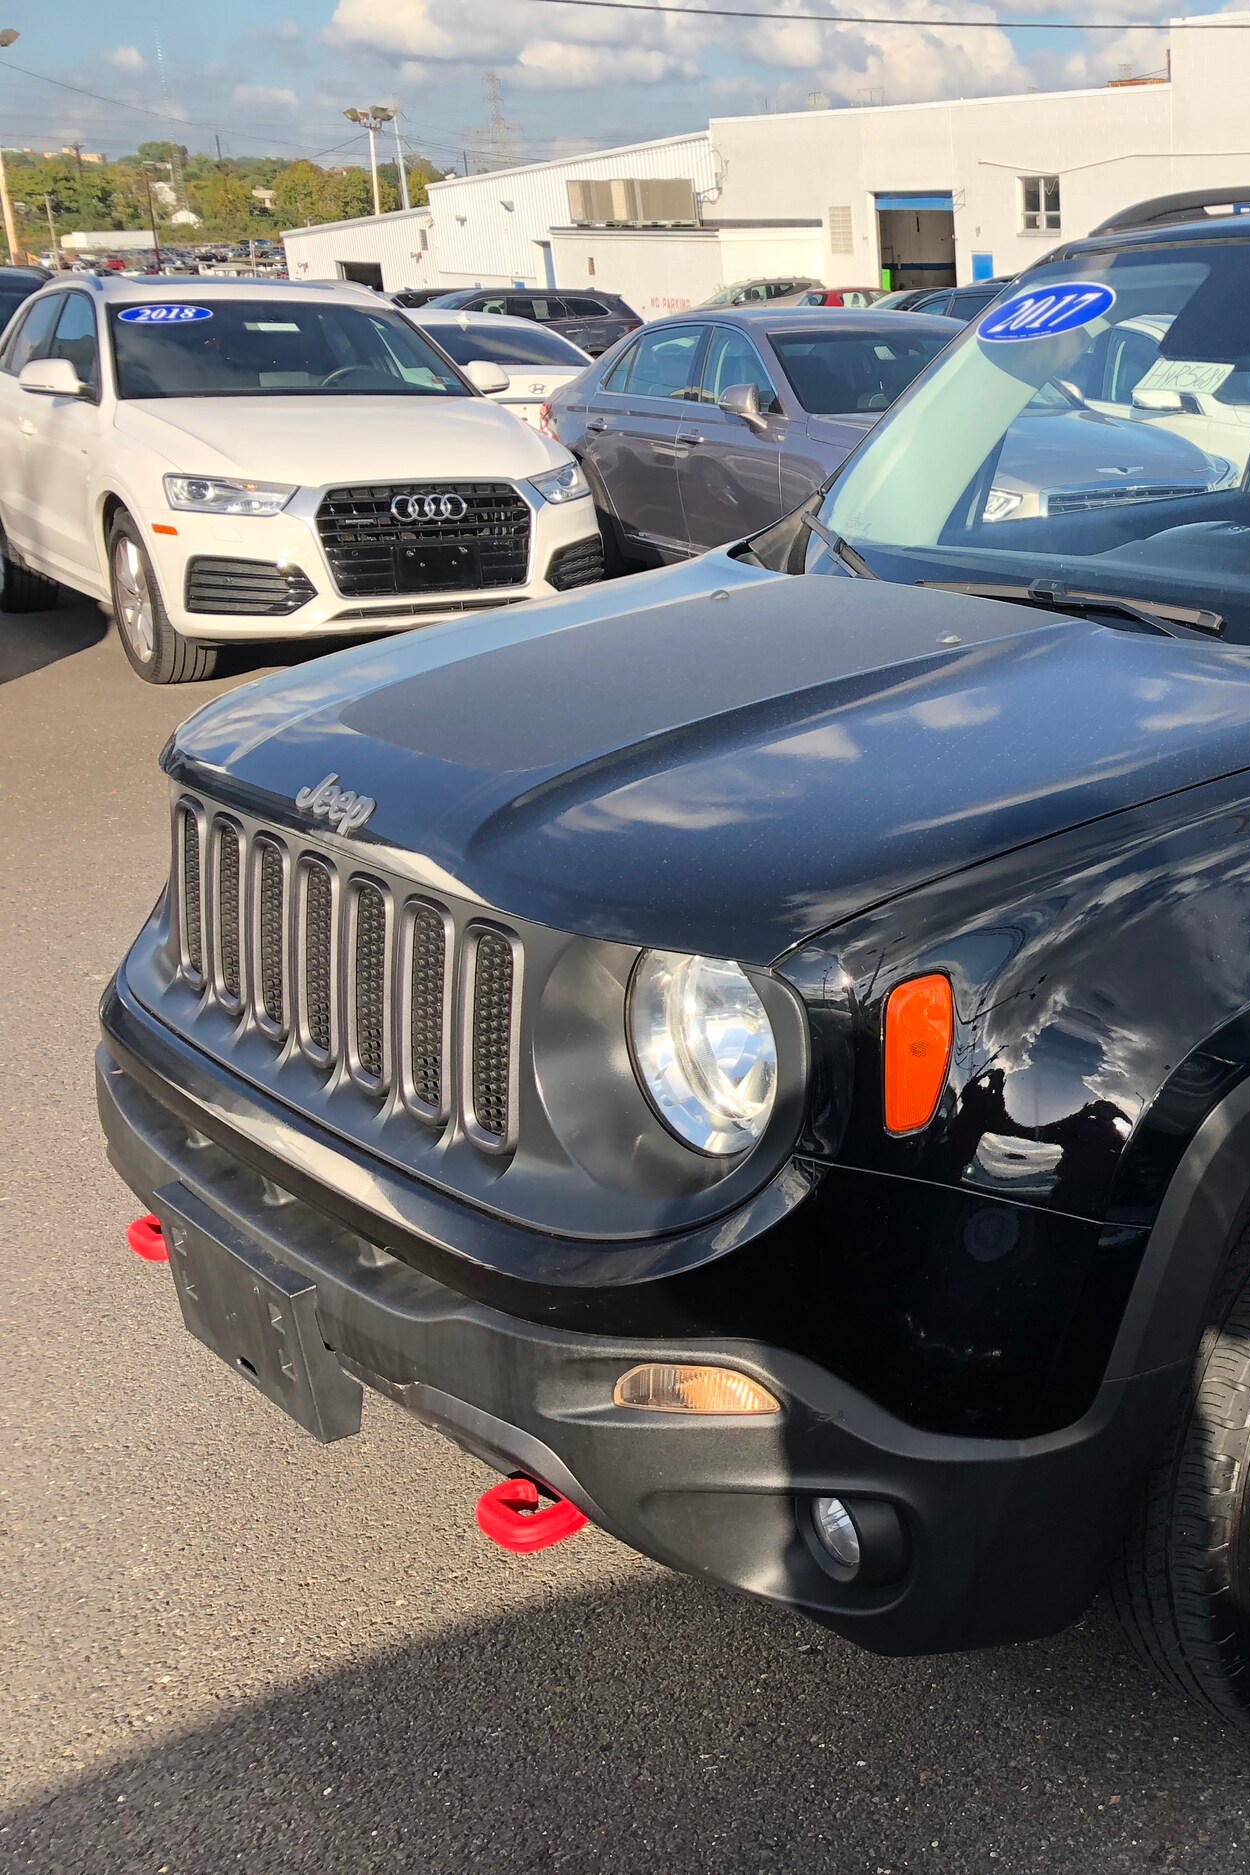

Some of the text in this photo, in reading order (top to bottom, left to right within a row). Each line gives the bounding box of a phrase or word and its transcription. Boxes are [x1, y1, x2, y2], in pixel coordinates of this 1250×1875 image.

[135, 307, 197, 321] 2018
[650, 297, 660, 308] NO
[986, 291, 1105, 334] 2017
[295, 772, 377, 837] Jeep
